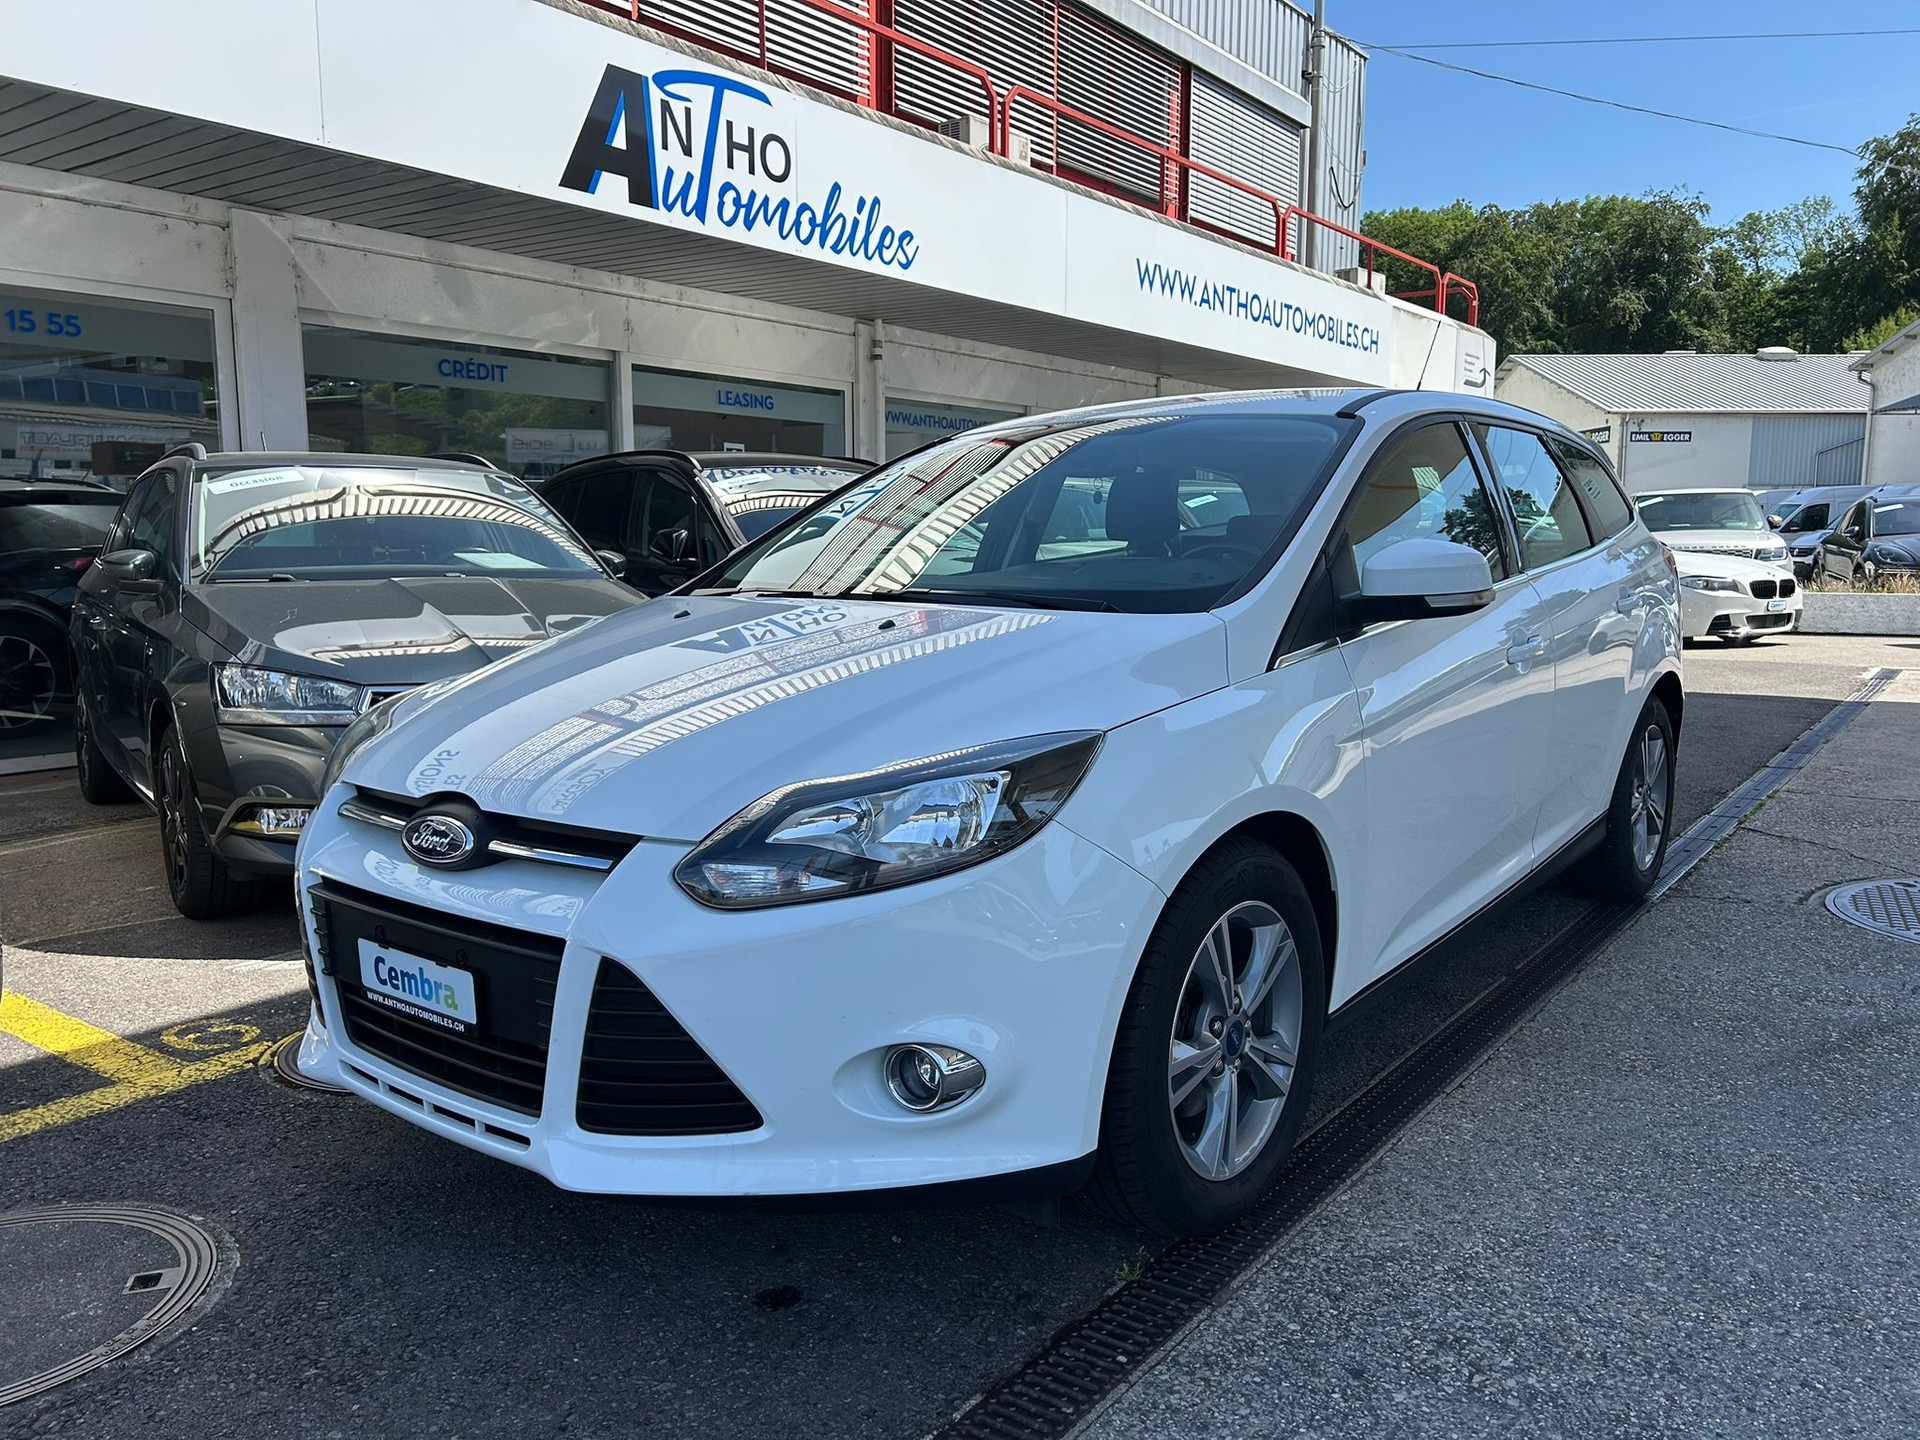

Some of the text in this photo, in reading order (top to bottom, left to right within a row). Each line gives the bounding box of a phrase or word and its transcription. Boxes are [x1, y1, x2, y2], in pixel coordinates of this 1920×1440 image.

[558, 63, 791, 224] ANTHO
[1136, 257, 1379, 355] WWW.ANTHOAUTOMOBILES.CH
[4, 308, 82, 338] 15 55
[438, 356, 508, 384] CRÉDIT
[717, 389, 775, 411] LEASING
[1631, 433, 1690, 441] EMIL EGGER
[229, 475, 284, 488] Occasion
[411, 821, 451, 853] Ford
[373, 955, 459, 1011] Cembra
[367, 990, 465, 1033] WWW.ANTHOAUTOMOBILES.CH
